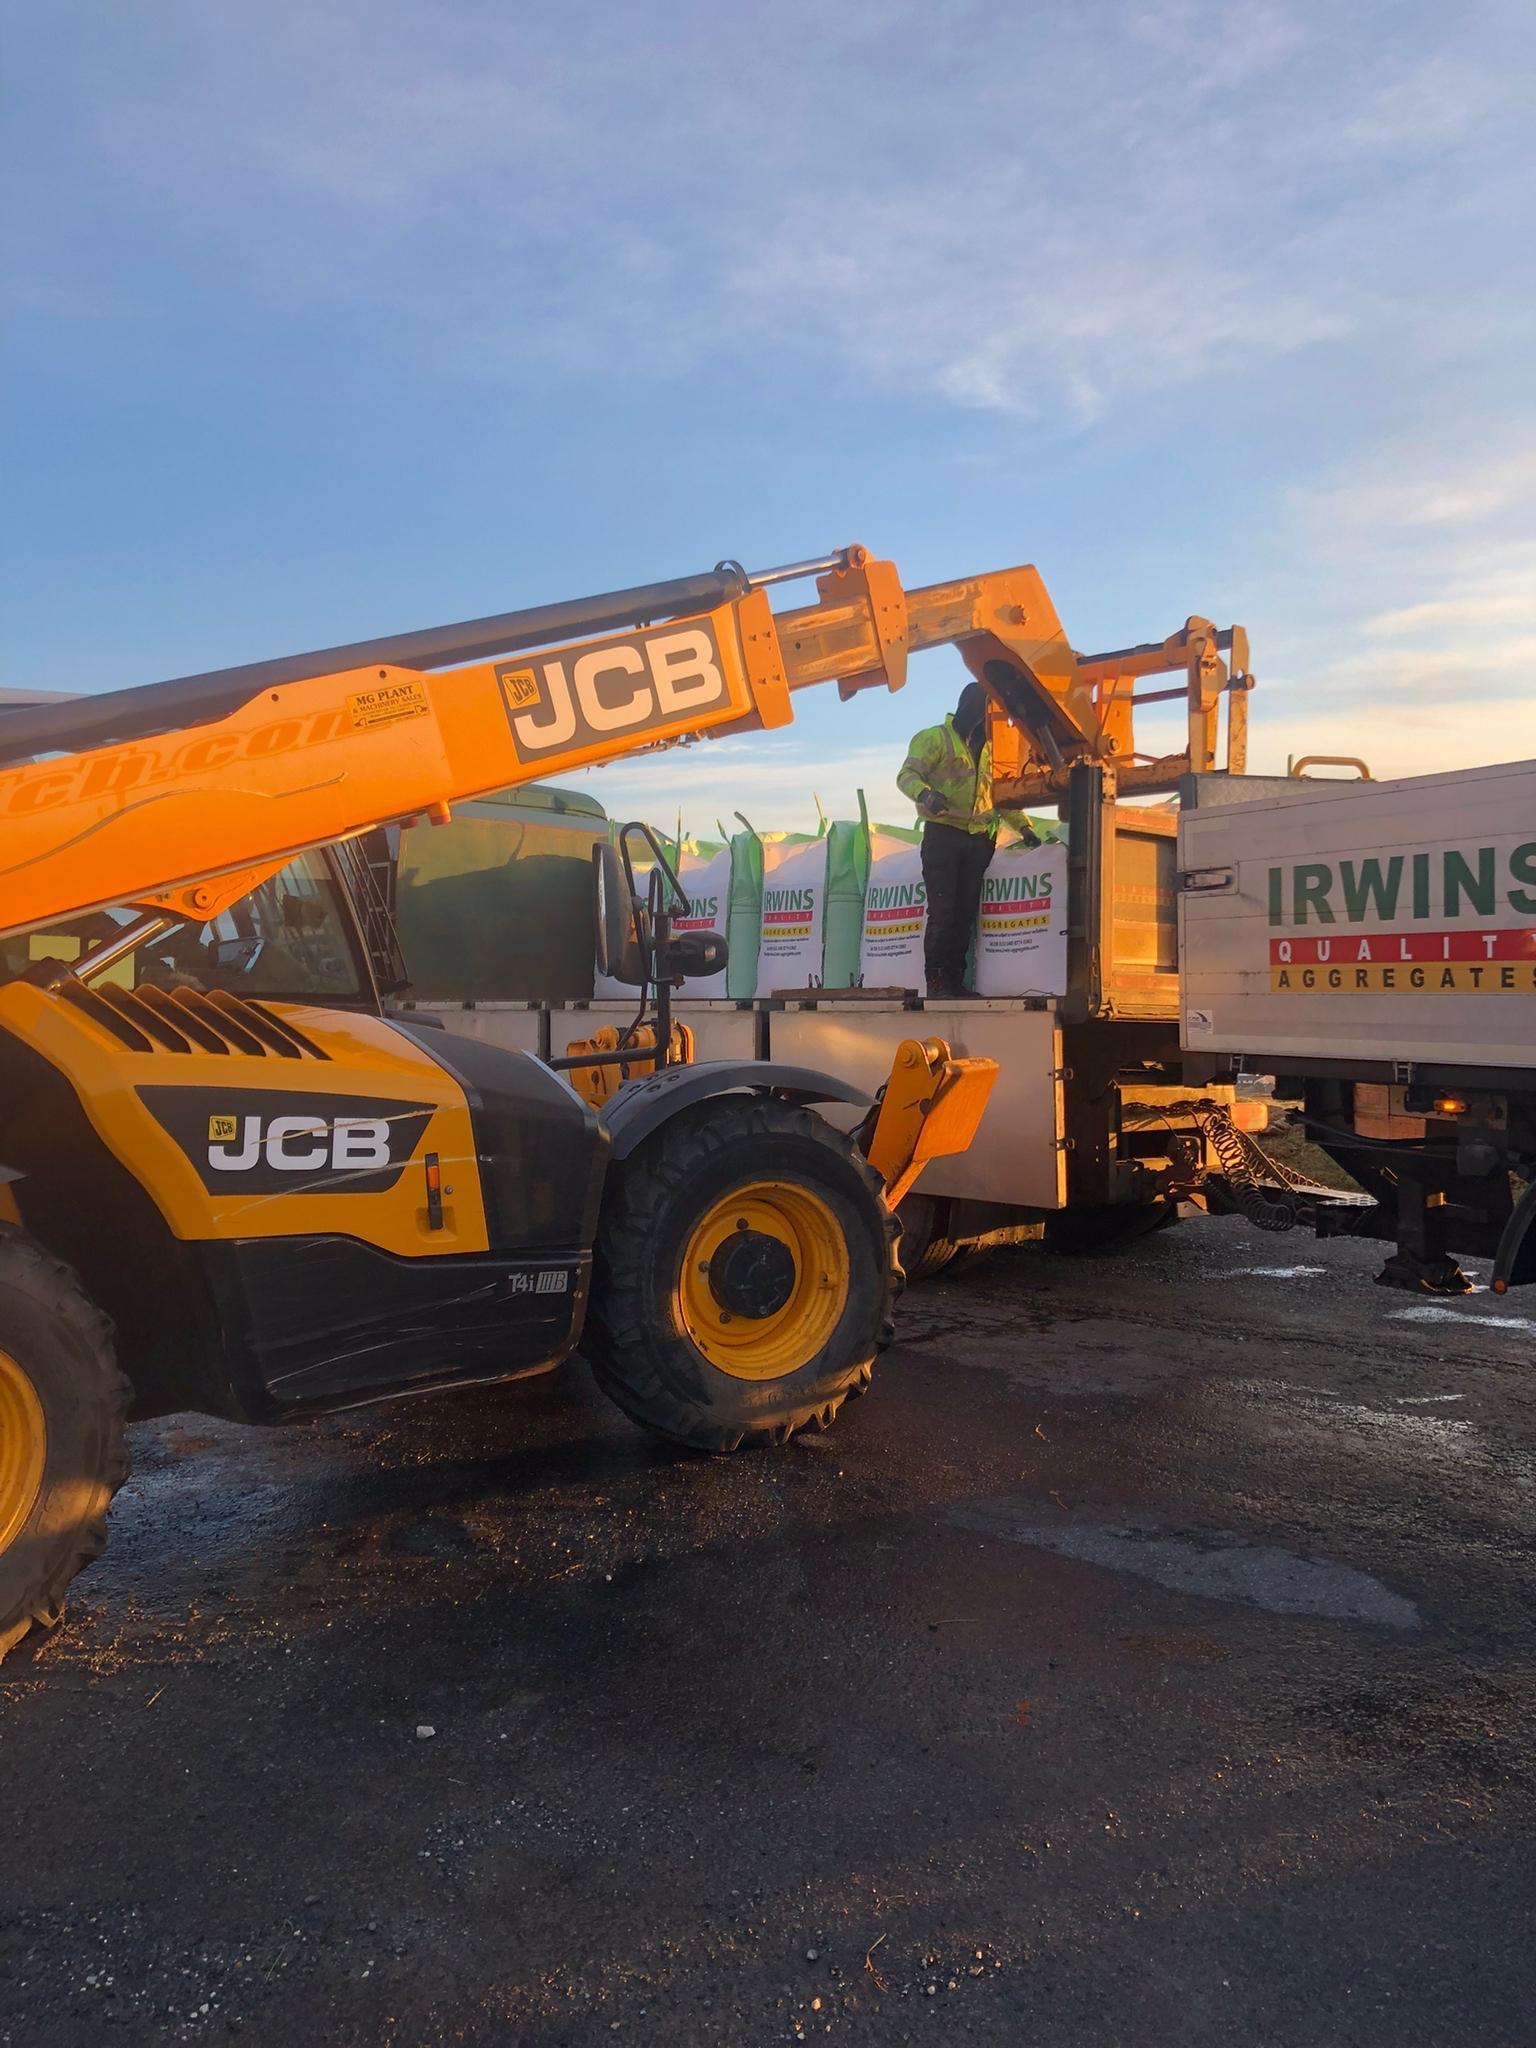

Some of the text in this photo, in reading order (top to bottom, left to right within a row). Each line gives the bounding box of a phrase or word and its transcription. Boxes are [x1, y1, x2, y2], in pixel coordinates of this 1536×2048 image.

[356, 685, 413, 705] MG PLANT
[512, 677, 535, 701] JCB
[513, 629, 722, 750] JCB
[360, 698, 400, 712] MACHINERY
[868, 882, 926, 908] IRWINS
[981, 872, 1053, 901] IRWINS
[1268, 841, 1536, 926] IRWINS
[764, 889, 814, 911] IRWINS
[1278, 966, 1536, 989] AGGREGATE
[215, 1119, 233, 1137] JCB
[208, 1116, 390, 1170] JCB
